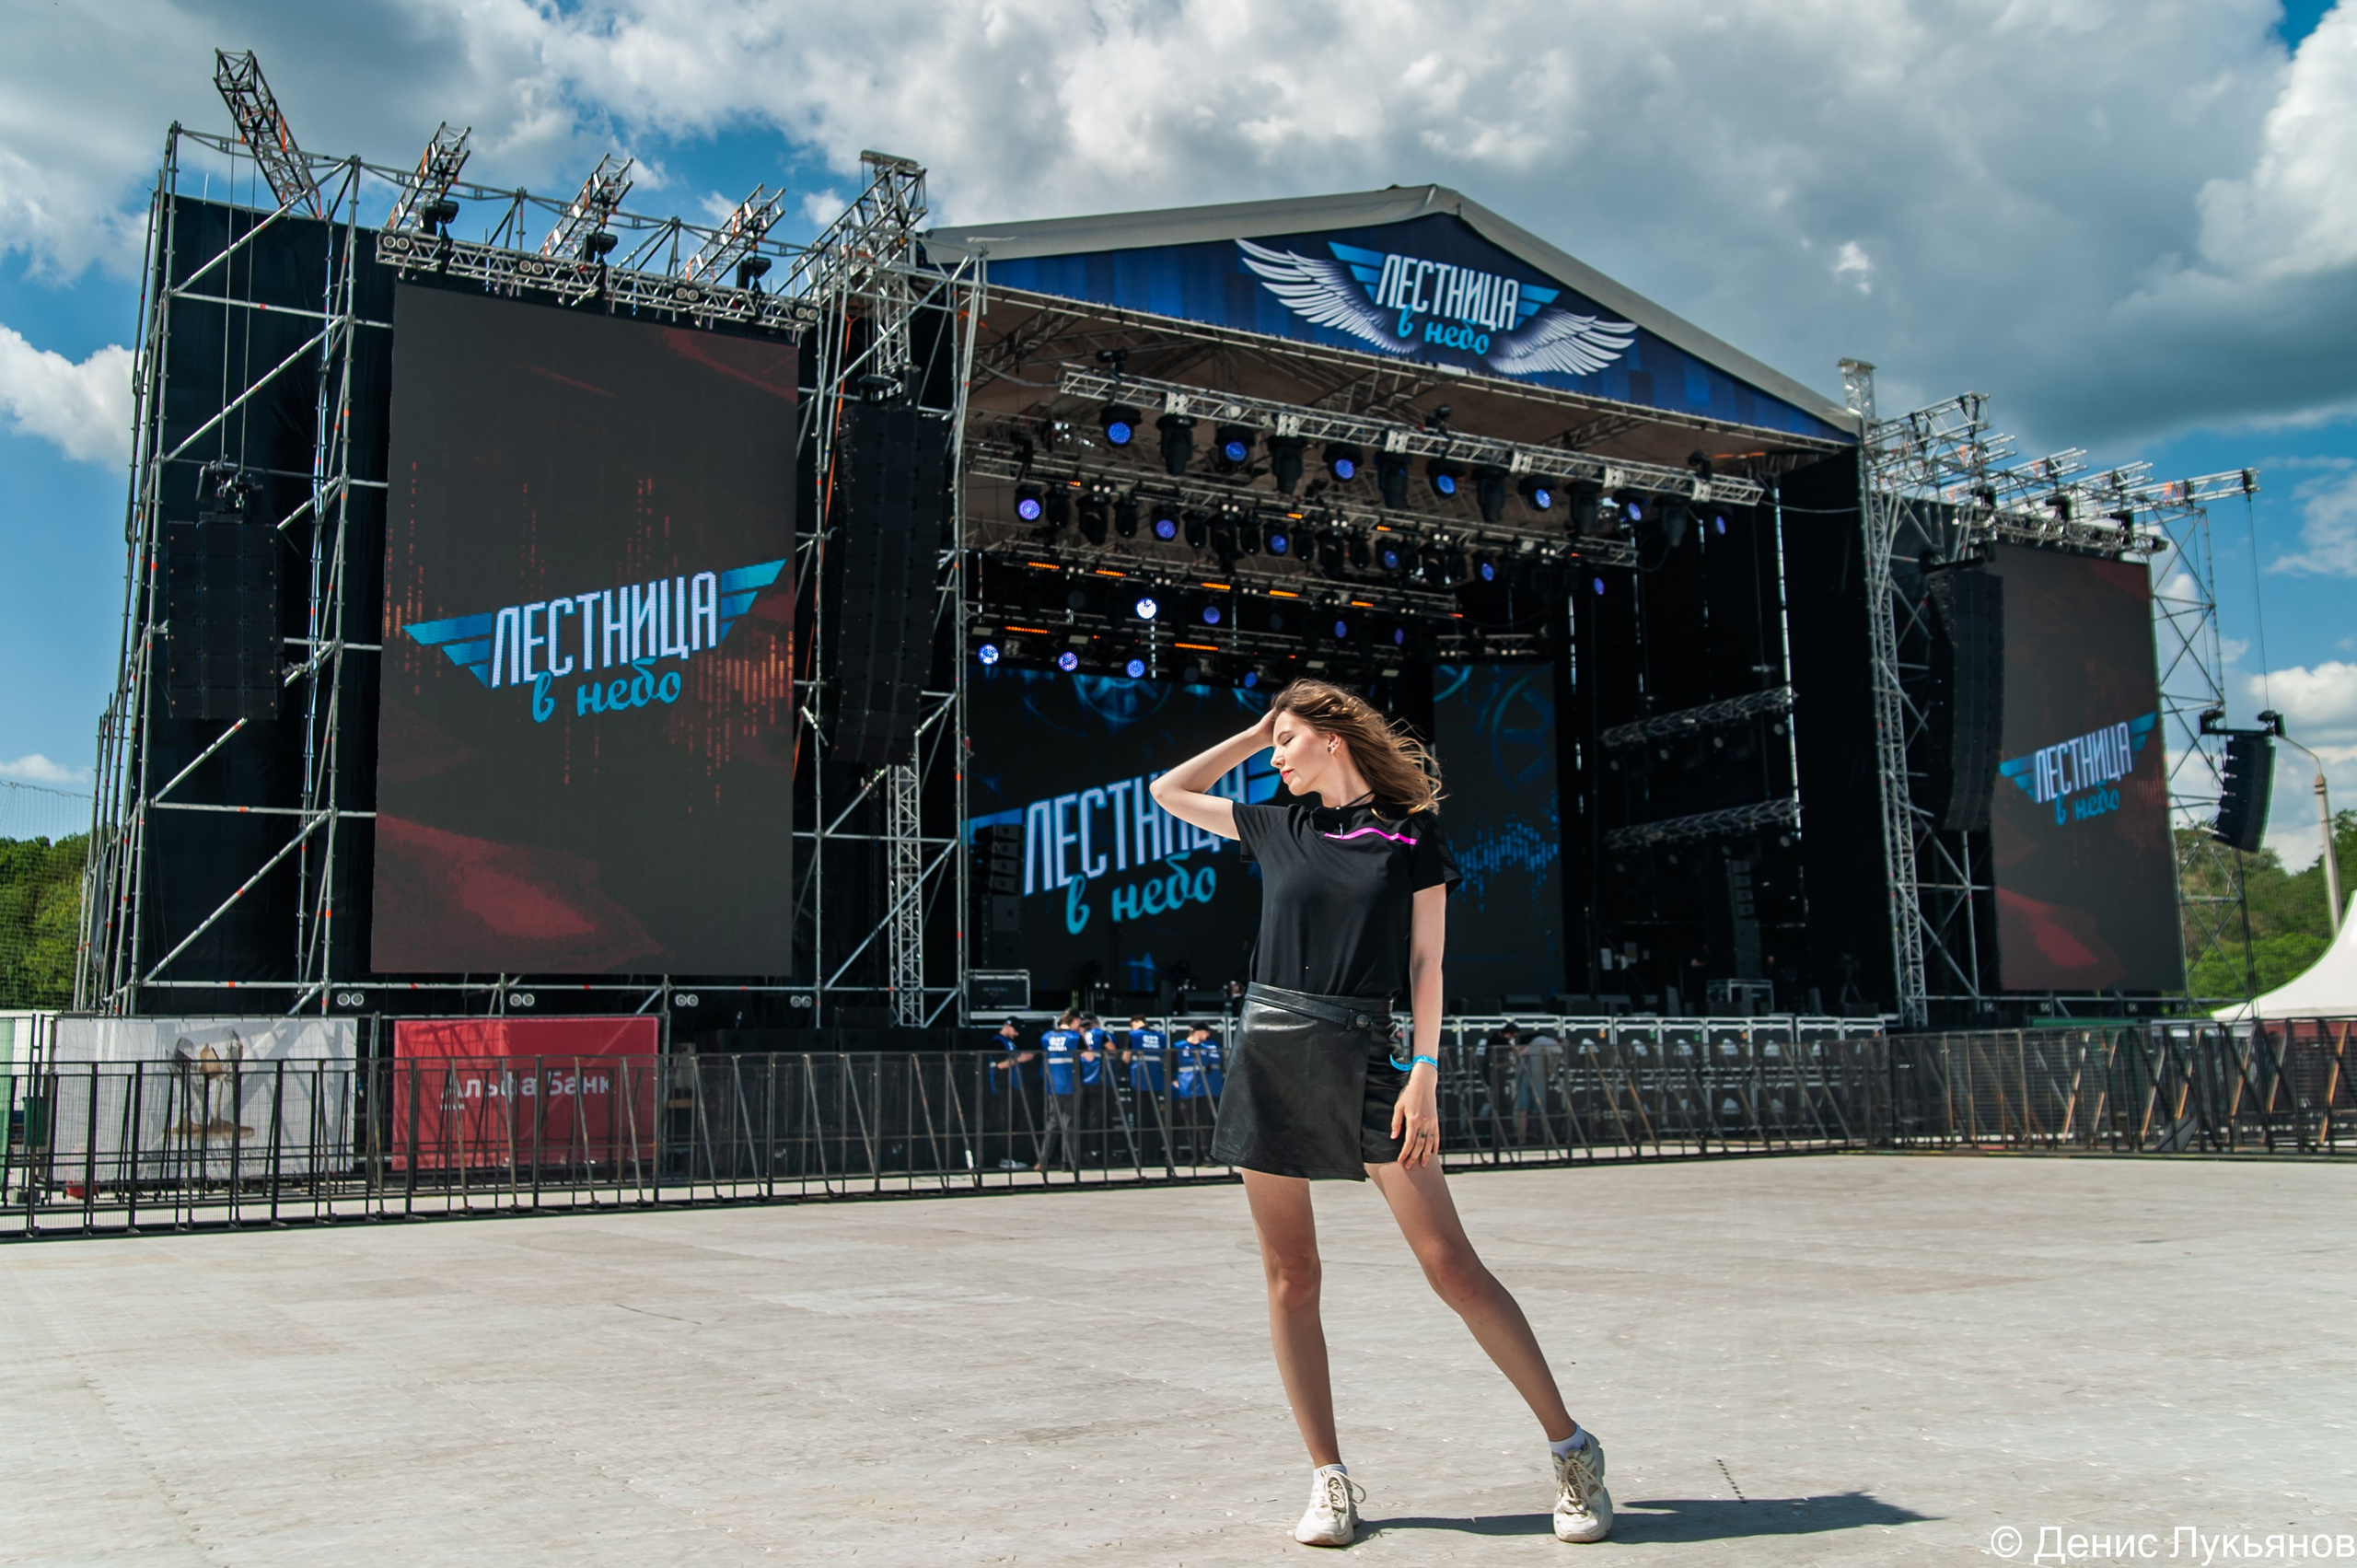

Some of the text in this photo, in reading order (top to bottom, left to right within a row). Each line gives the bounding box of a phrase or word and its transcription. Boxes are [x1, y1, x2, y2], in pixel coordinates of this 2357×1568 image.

[1376, 254, 1519, 331] ЛЕСТНИЦА
[1398, 305, 1490, 355] в небо
[492, 571, 717, 690] ЛЕСТНИЦА
[532, 656, 681, 724] в небо
[2036, 722, 2132, 804] ЛЕСТНИЦА
[2055, 780, 2119, 826] в небо
[1066, 852, 1216, 935] в небо
